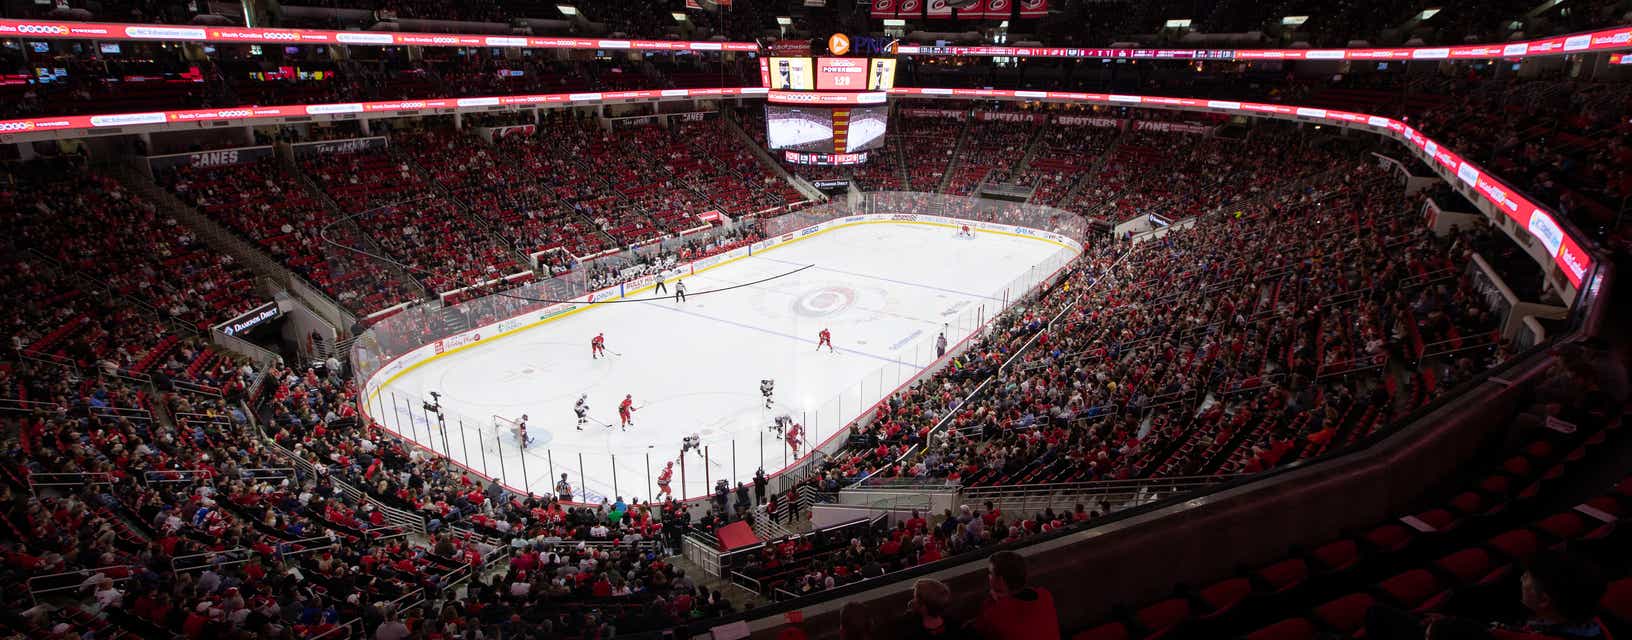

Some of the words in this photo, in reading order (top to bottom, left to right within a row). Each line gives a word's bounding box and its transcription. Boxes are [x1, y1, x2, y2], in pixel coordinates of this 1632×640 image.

[984, 111, 1033, 122] BUFFALO
[1058, 116, 1117, 127] BROTHERS
[1137, 121, 1170, 133] ZONE
[191, 151, 238, 168] CANES
[802, 225, 819, 235] GEICO
[234, 317, 261, 333] DIAMOND
[260, 308, 278, 321] DIRECT
